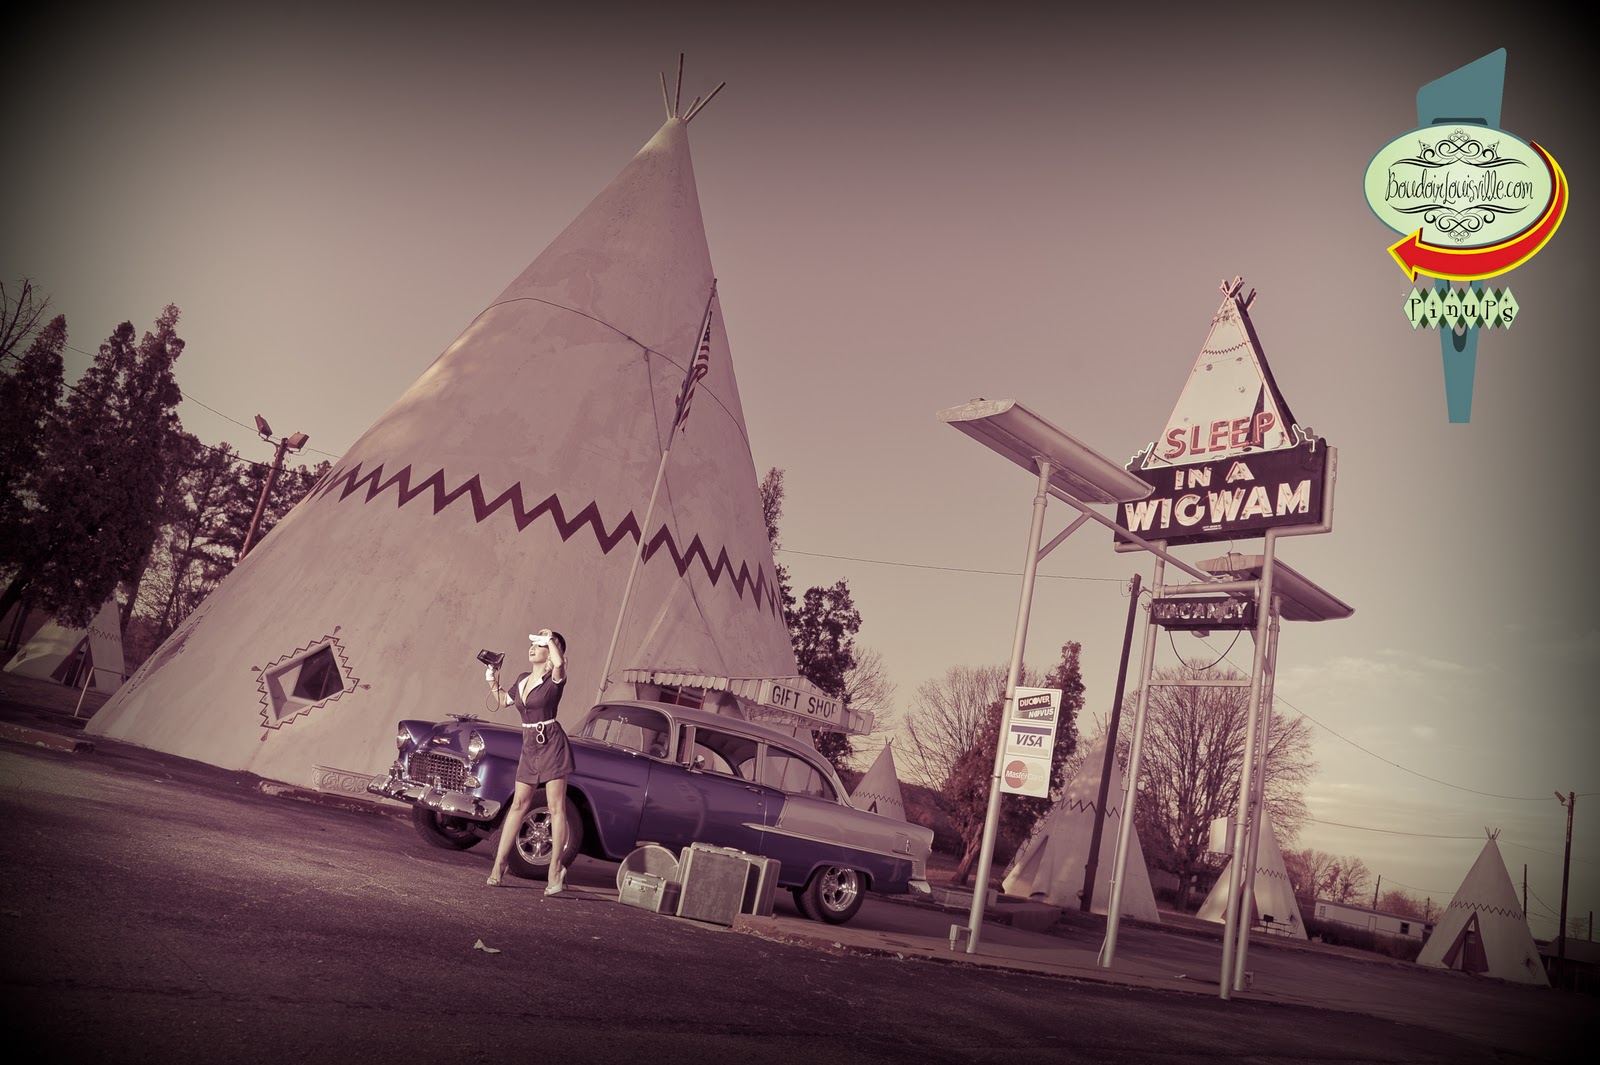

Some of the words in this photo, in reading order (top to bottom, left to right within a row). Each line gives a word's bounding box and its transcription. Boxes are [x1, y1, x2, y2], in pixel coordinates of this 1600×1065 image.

[1164, 411, 1275, 459] SLEEP
[1174, 466, 1212, 490] IN
[1225, 461, 1255, 483] A
[1125, 479, 1311, 532] WIGWAM
[772, 685, 800, 709] GIFT
[807, 696, 838, 718] SHOP
[1028, 708, 1054, 719] NOVUS
[1016, 734, 1043, 747] VISA
